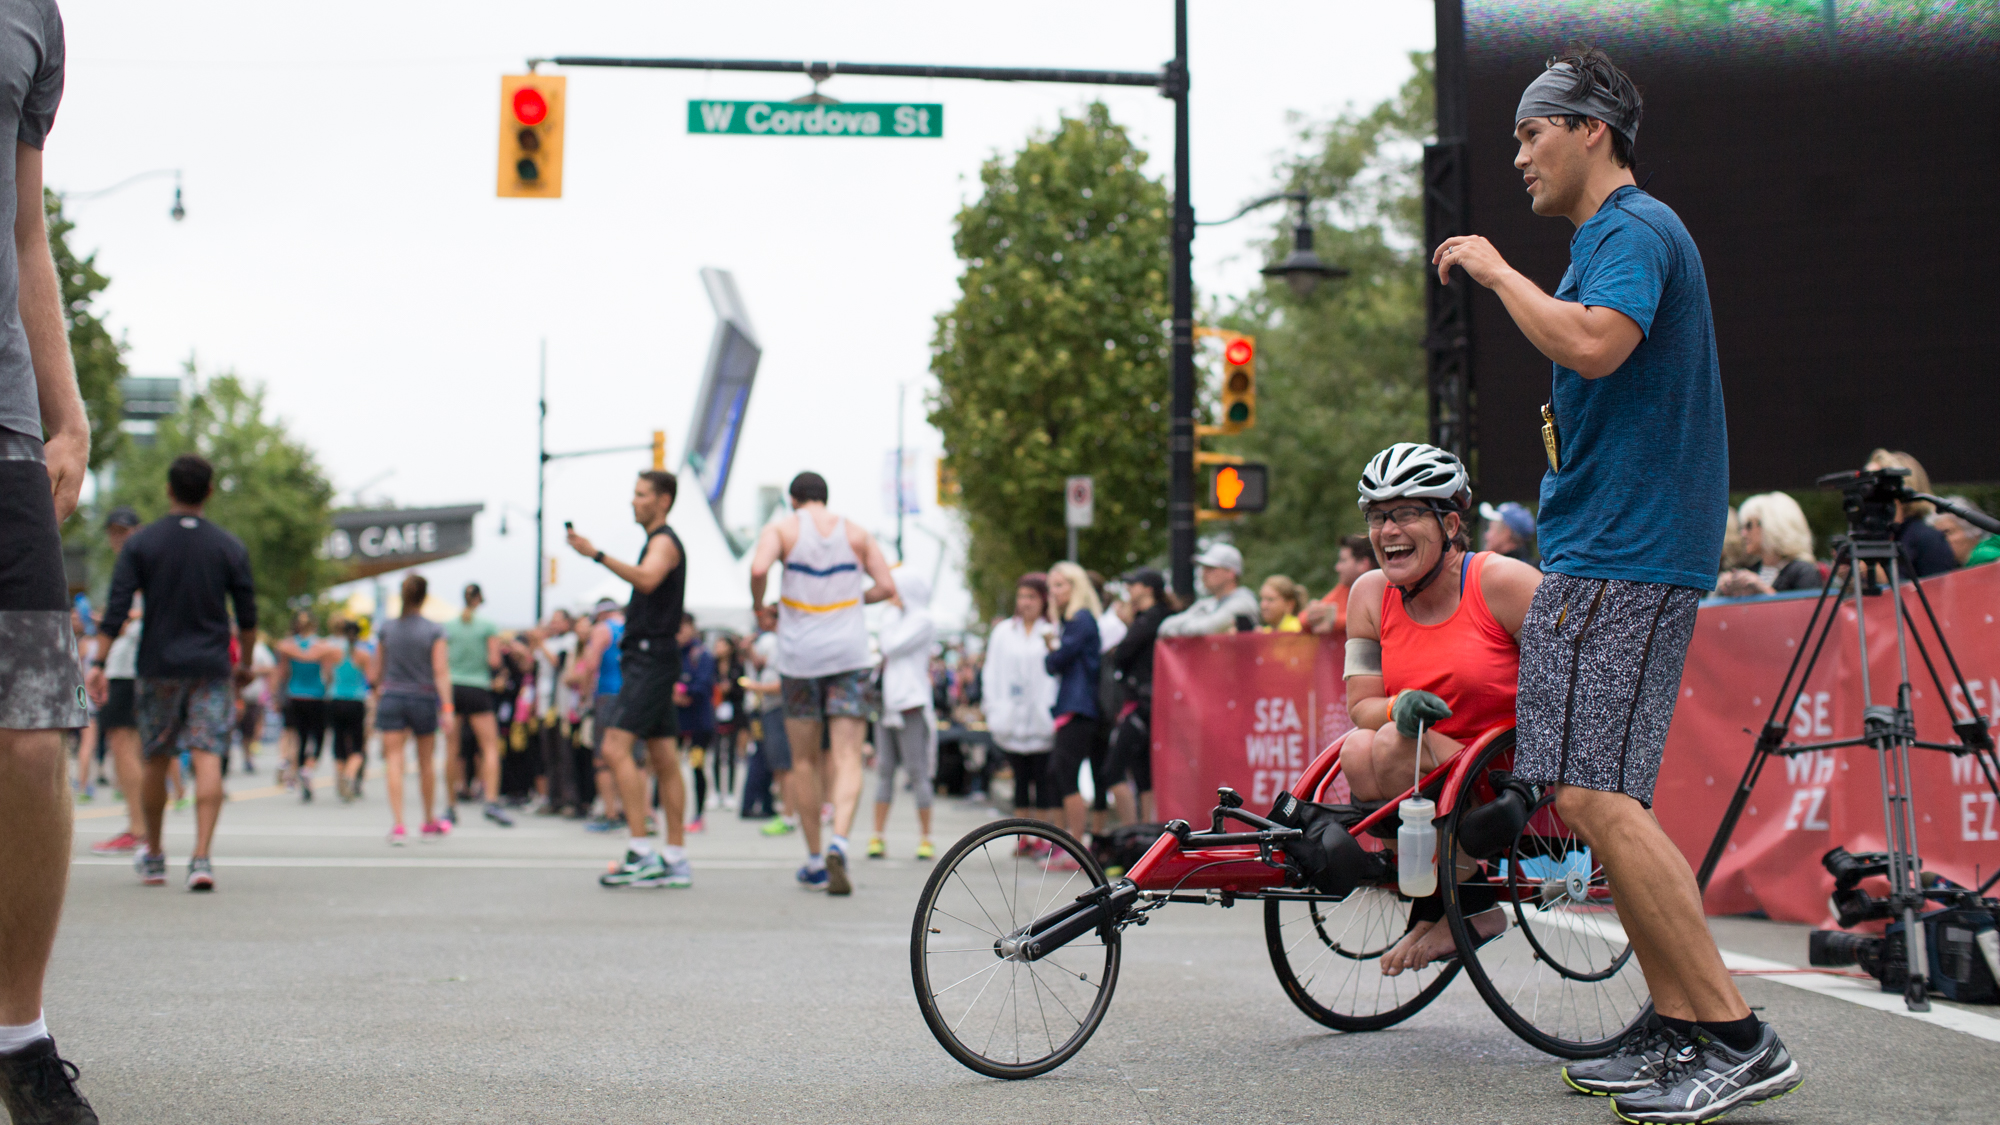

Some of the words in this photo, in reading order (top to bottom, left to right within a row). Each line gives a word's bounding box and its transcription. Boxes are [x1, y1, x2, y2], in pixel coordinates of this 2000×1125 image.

[700, 103, 735, 132] W
[745, 103, 881, 135] Cordova
[893, 105, 931, 135] St
[359, 521, 438, 557] CAFE
[1254, 697, 1301, 732] SEA
[1245, 733, 1303, 768] WHE
